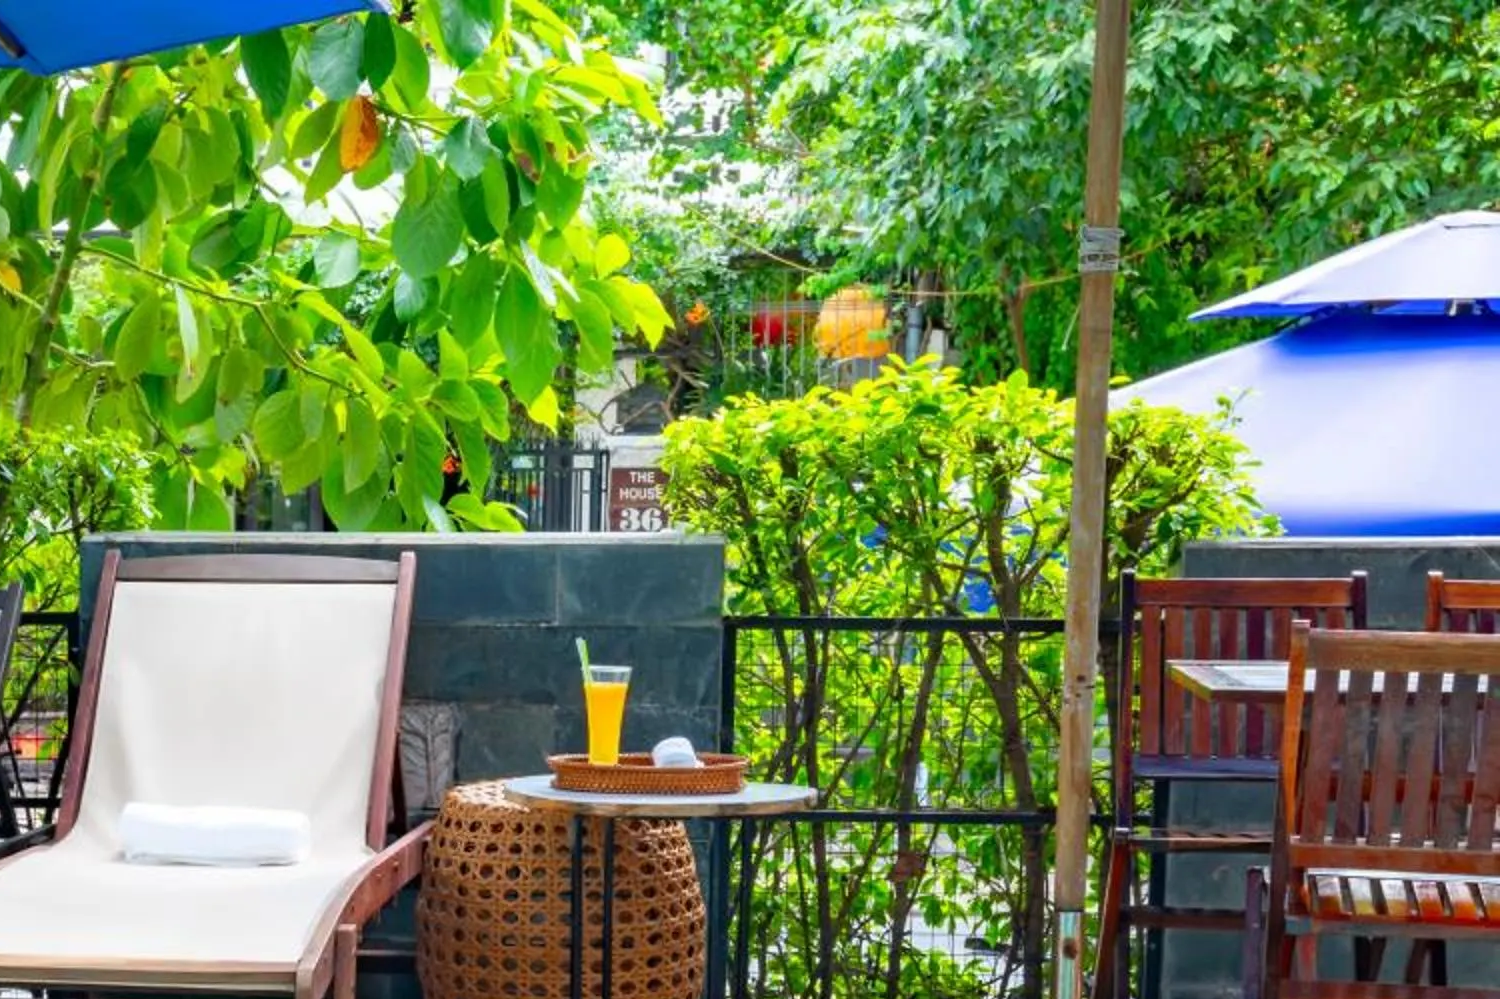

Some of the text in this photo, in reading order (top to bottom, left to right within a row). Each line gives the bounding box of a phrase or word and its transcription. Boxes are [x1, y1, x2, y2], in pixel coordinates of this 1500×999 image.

[628, 471, 656, 483] THE
[619, 484, 664, 500] HOUSE
[619, 507, 663, 532] 36
